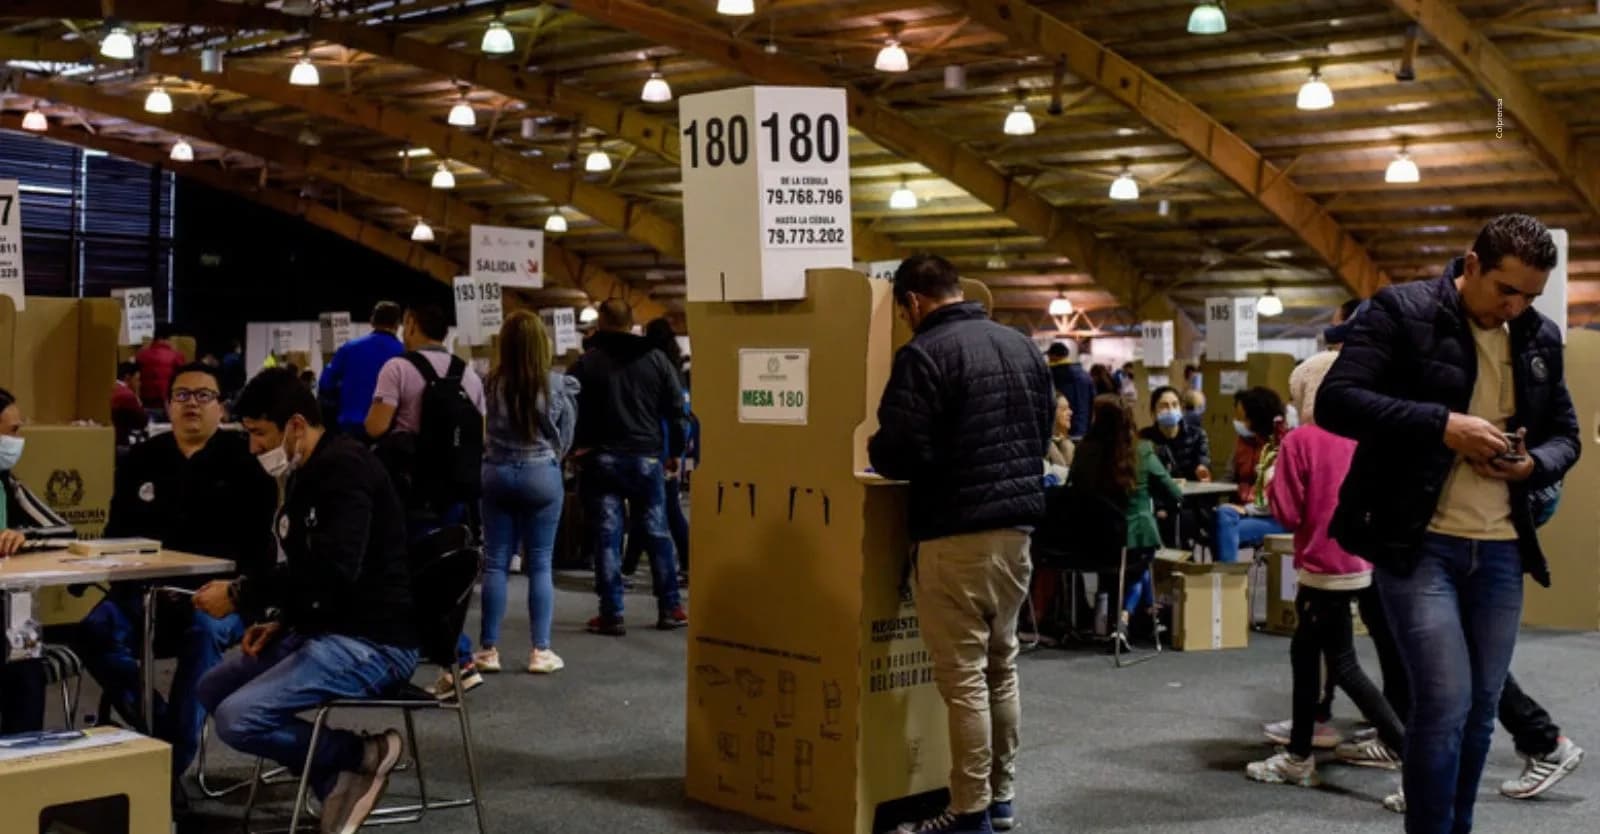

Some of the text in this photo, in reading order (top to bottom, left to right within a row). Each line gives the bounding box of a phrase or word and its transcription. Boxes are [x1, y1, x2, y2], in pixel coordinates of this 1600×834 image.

[683, 114, 748, 168] 180
[761, 112, 841, 164] 180
[780, 176, 789, 185] DE
[791, 176, 800, 185] LA
[766, 188, 844, 205] 79.768.796
[775, 216, 797, 225] HASTA
[798, 216, 808, 224] LA
[767, 228, 845, 244] 79.773.202
[476, 258, 517, 272] SALIDA
[456, 283, 475, 300] 193
[479, 282, 500, 300] 193
[1211, 304, 1230, 321] 185
[1144, 327, 1163, 339] 191
[742, 390, 804, 407] MESA 180
